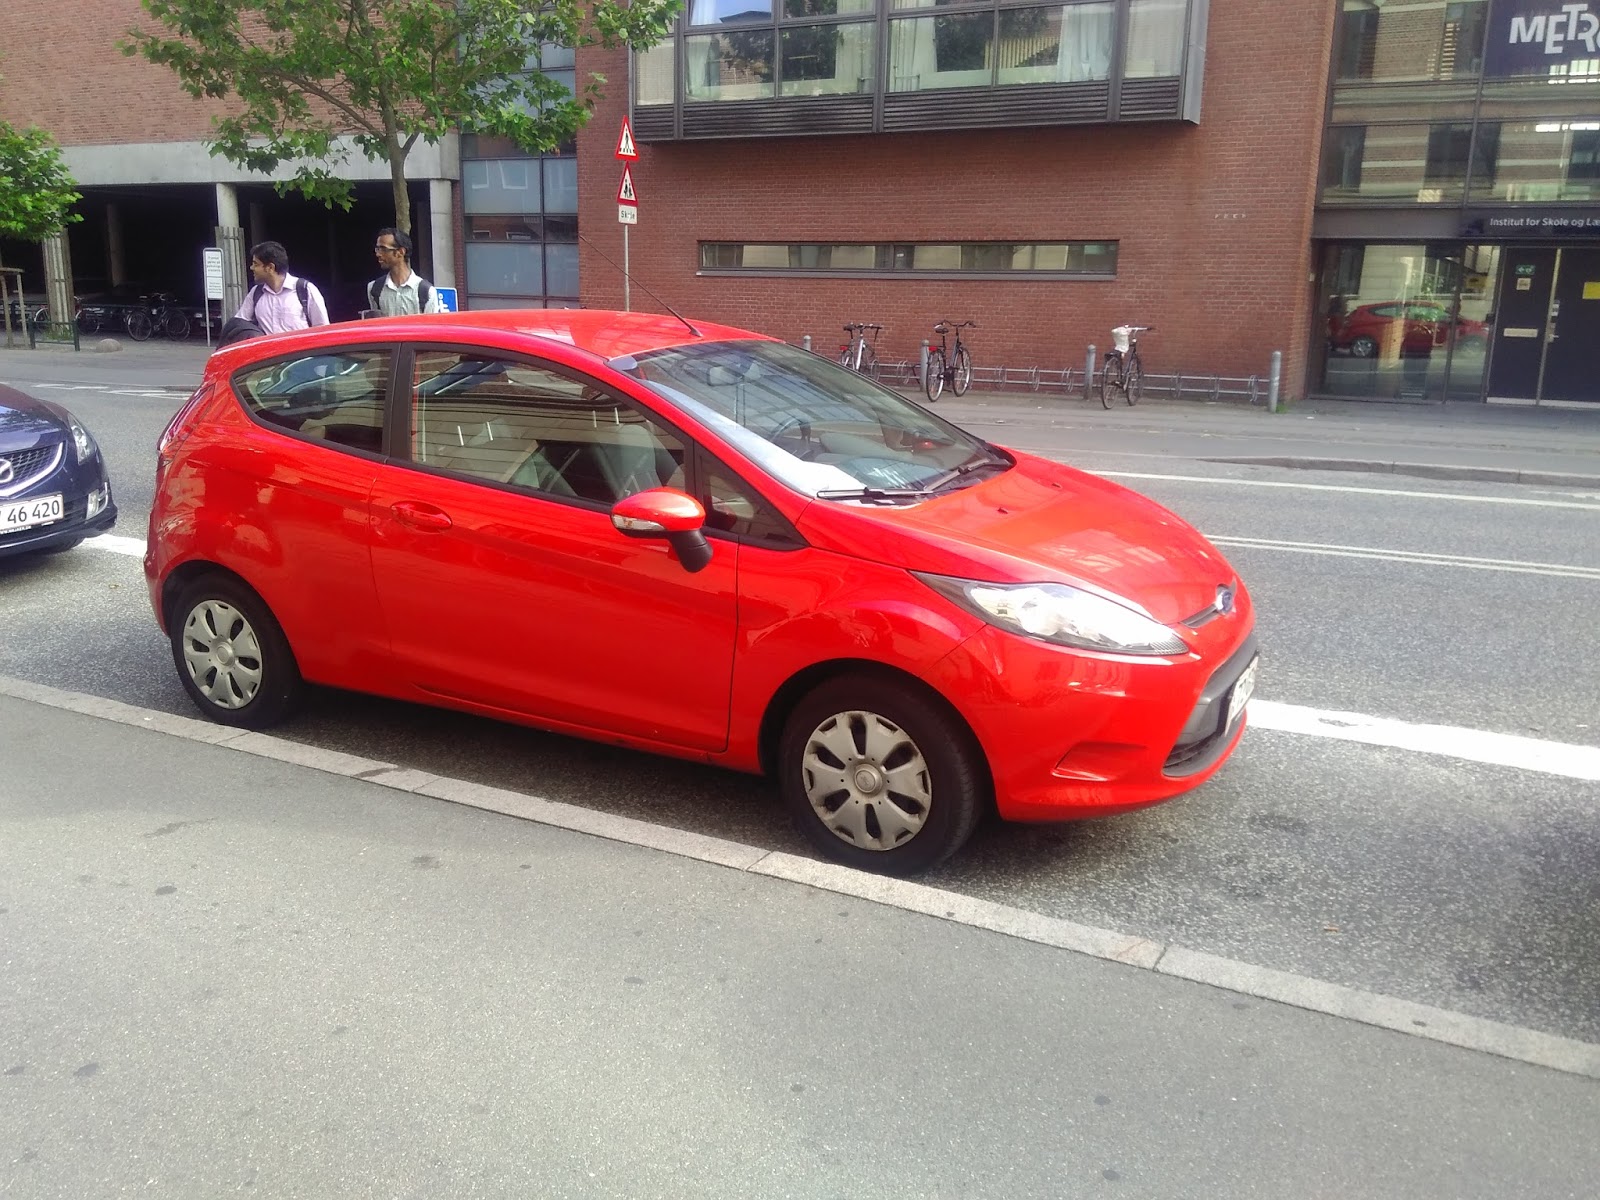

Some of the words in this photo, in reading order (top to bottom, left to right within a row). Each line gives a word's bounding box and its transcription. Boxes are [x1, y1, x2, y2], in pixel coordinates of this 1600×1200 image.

[1509, 4, 1600, 54] METR
[1490, 217, 1524, 226] Institut
[1526, 217, 1540, 226] for
[1542, 217, 1569, 226] Skole
[1571, 219, 1584, 228] og
[7, 506, 27, 523] 46
[32, 500, 60, 519] 420
